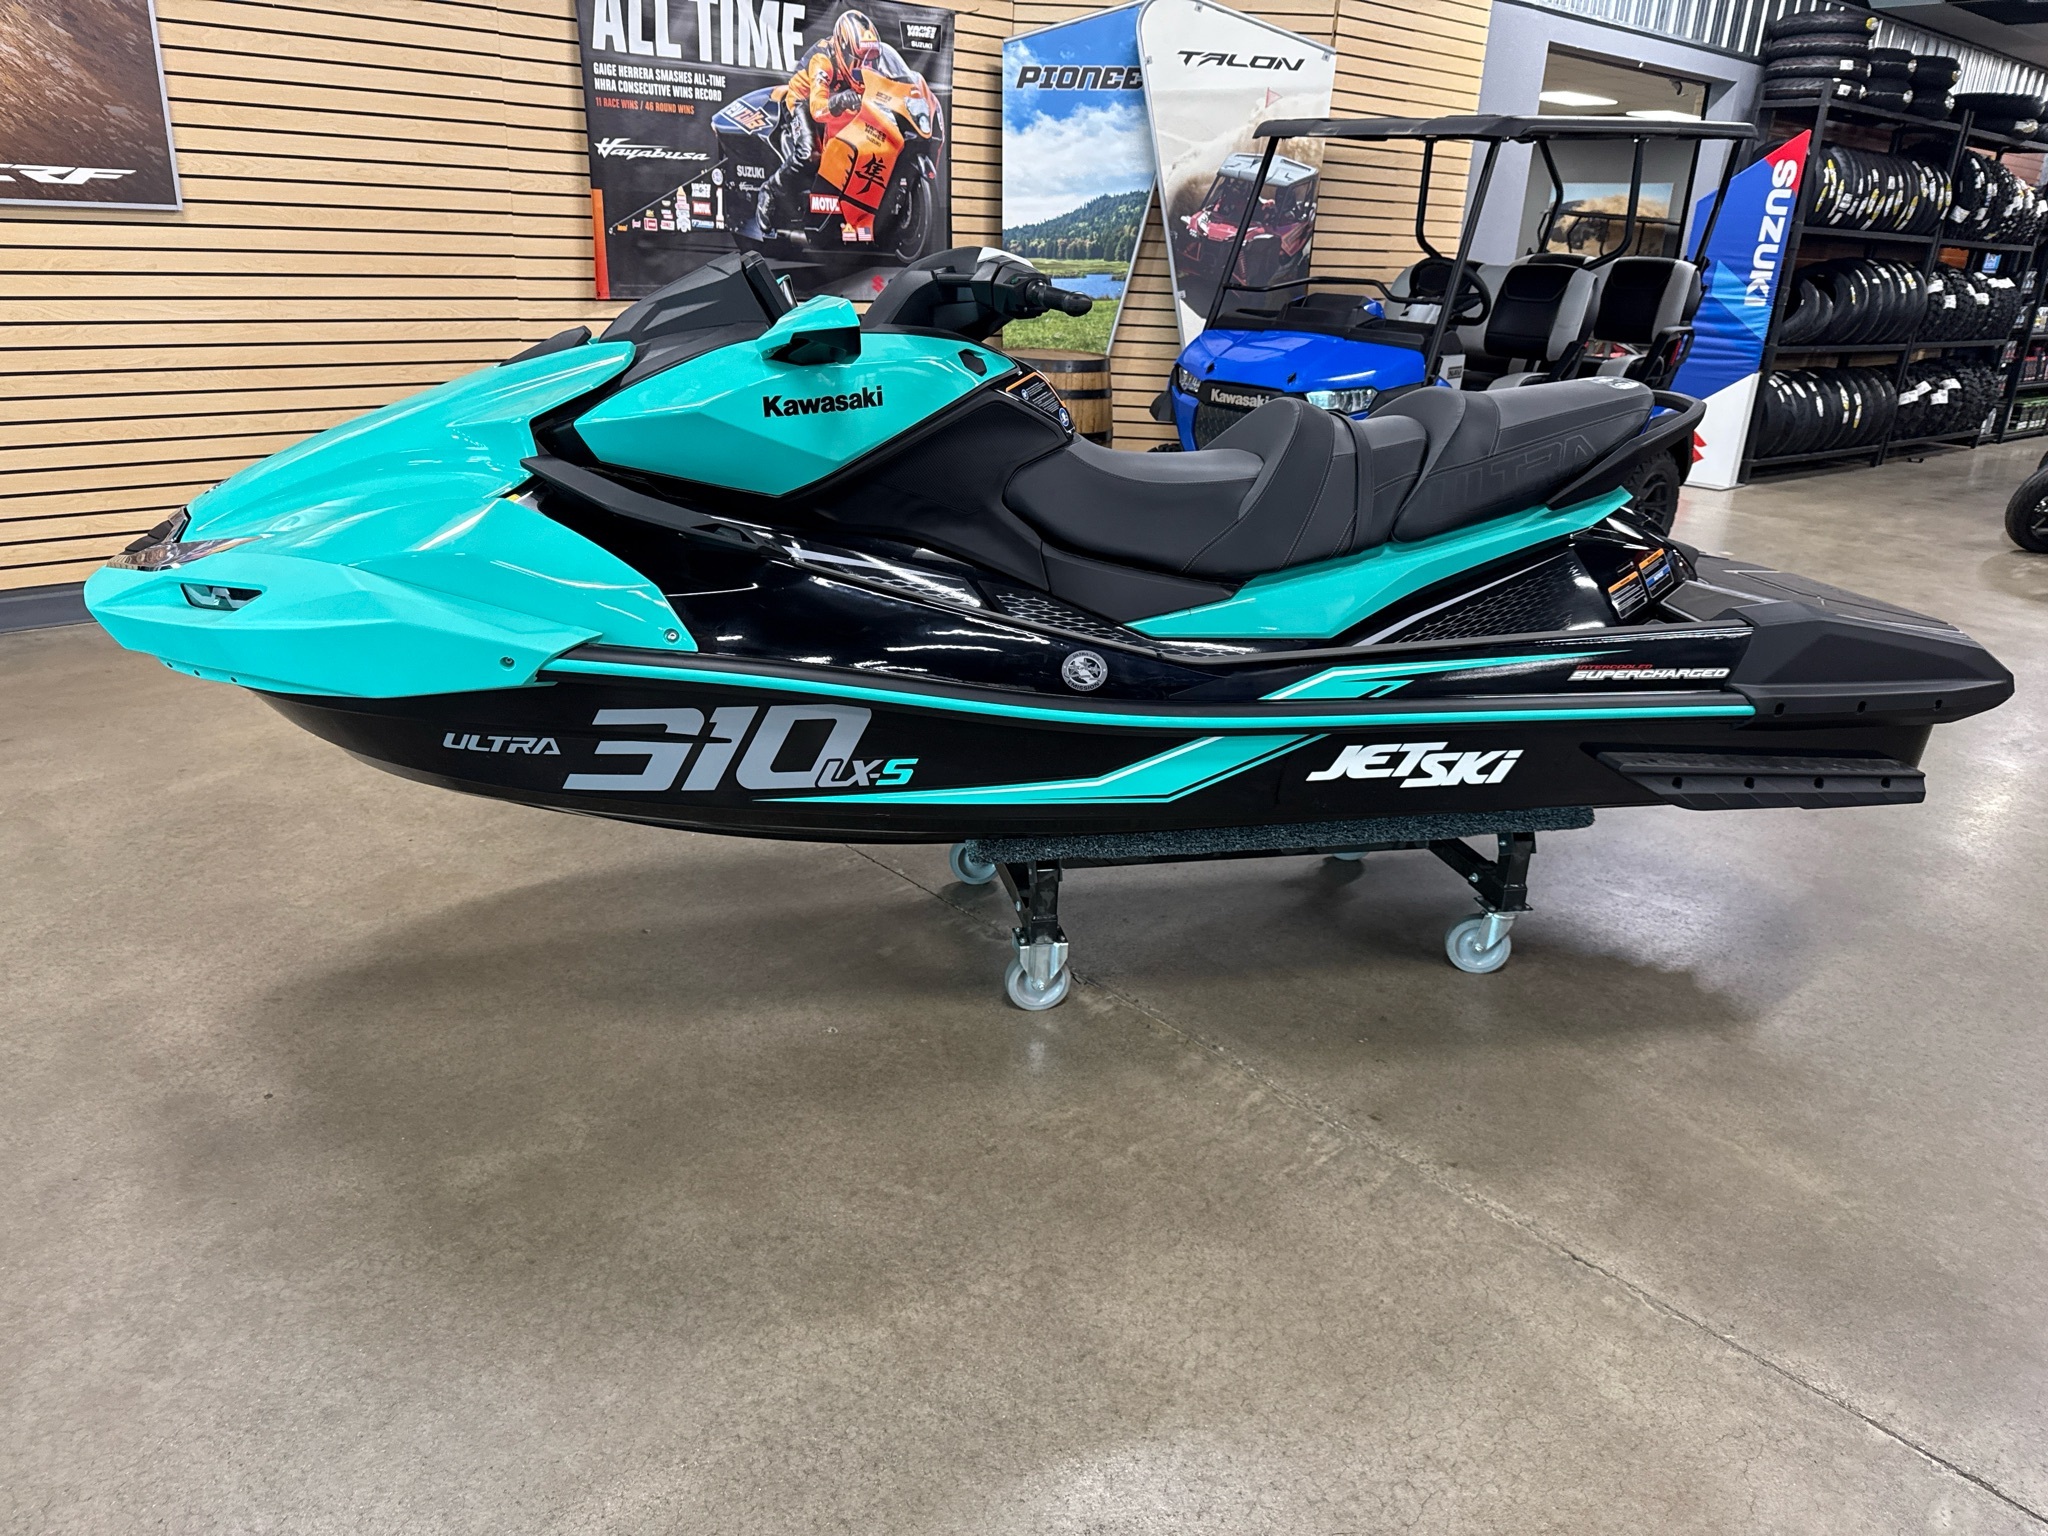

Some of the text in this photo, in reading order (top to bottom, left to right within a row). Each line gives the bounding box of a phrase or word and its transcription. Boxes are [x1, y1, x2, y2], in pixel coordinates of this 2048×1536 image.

[592, 0, 806, 72] ALL TIME
[911, 40, 933, 50] SUZUKI
[1176, 50, 1305, 71] TALON
[593, 62, 726, 88] GAIGE HERRERA SMASHES ALL-TIME
[594, 77, 722, 102] NHRA CONSECUTIVE WINS RECORD
[595, 96, 602, 107] 11
[603, 97, 620, 109] RACE
[620, 99, 639, 110] WINS
[644, 100, 654, 111] 46
[655, 102, 677, 113] ROUND
[678, 104, 695, 115] WINS
[594, 138, 711, 161] Hayabusa
[736, 164, 765, 179] SUZUKI
[1744, 159, 1798, 307] SUZUKI
[762, 386, 884, 418] Kawasaki
[1568, 668, 1730, 682] SUPERCHARGED
[442, 732, 562, 756] ULTRA
[562, 704, 872, 792] 310
